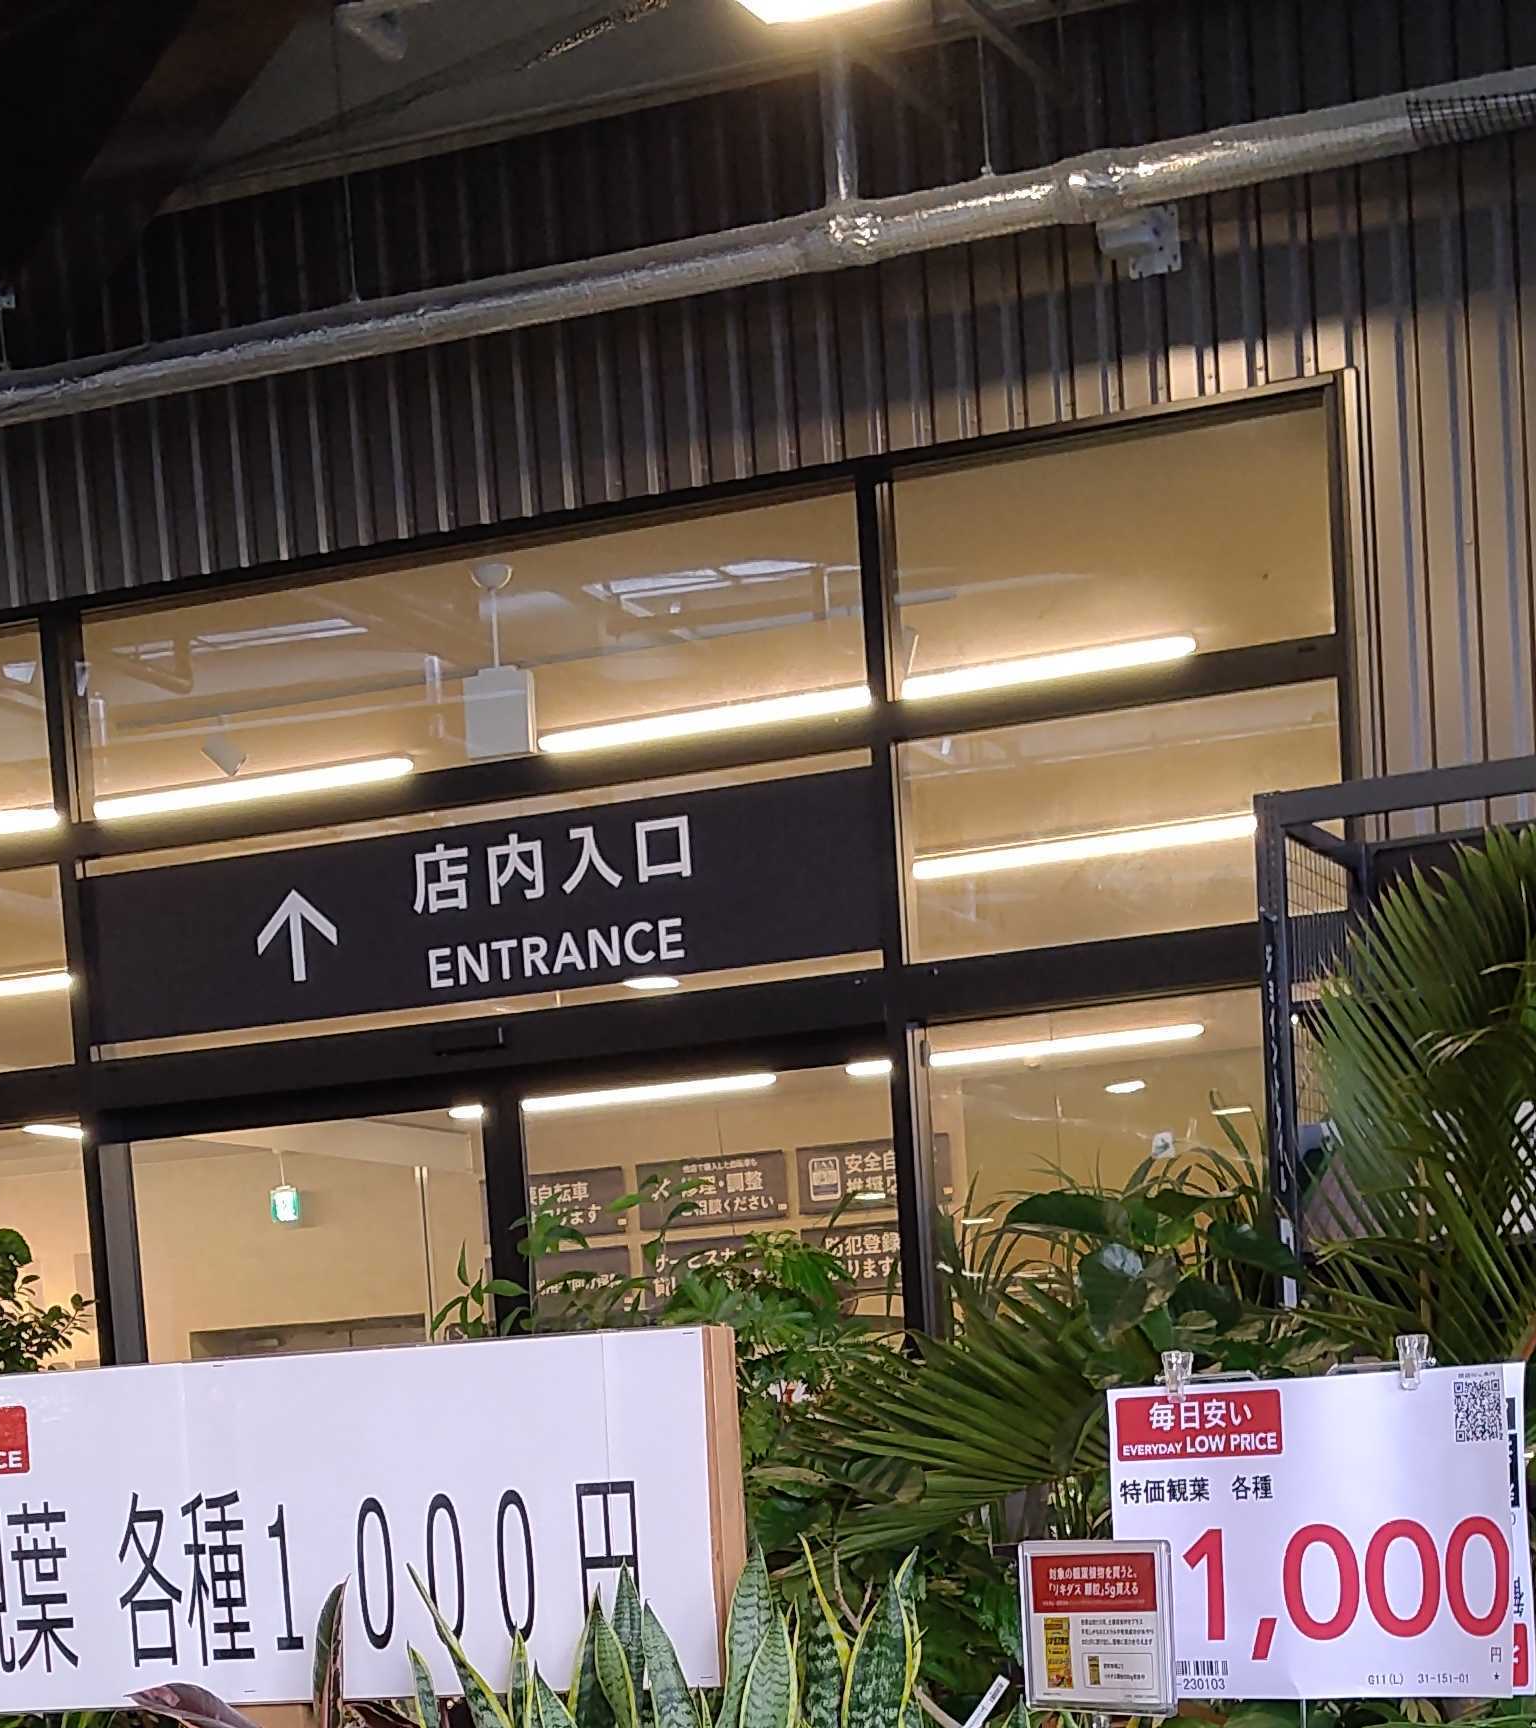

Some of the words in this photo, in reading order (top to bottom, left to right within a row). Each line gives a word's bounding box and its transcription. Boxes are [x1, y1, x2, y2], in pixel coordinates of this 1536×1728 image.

[412, 815, 693, 914] 店内入口
[427, 917, 686, 989] ENTRANCE
[1148, 1397, 1253, 1432] 毎日安い
[1122, 1442, 1183, 1457] EVERYDAY
[1185, 1434, 1226, 1454] LOW
[1229, 1431, 1279, 1451] PRICE
[1119, 1476, 1211, 1505] 特価観葉
[1231, 1474, 1274, 1502] 各種
[1181, 1514, 1511, 1661] 1,000
[1490, 1646, 1503, 1664] 円
[1367, 1673, 1404, 1687] G11(L)
[1417, 1672, 1470, 1686] 31-151-01
